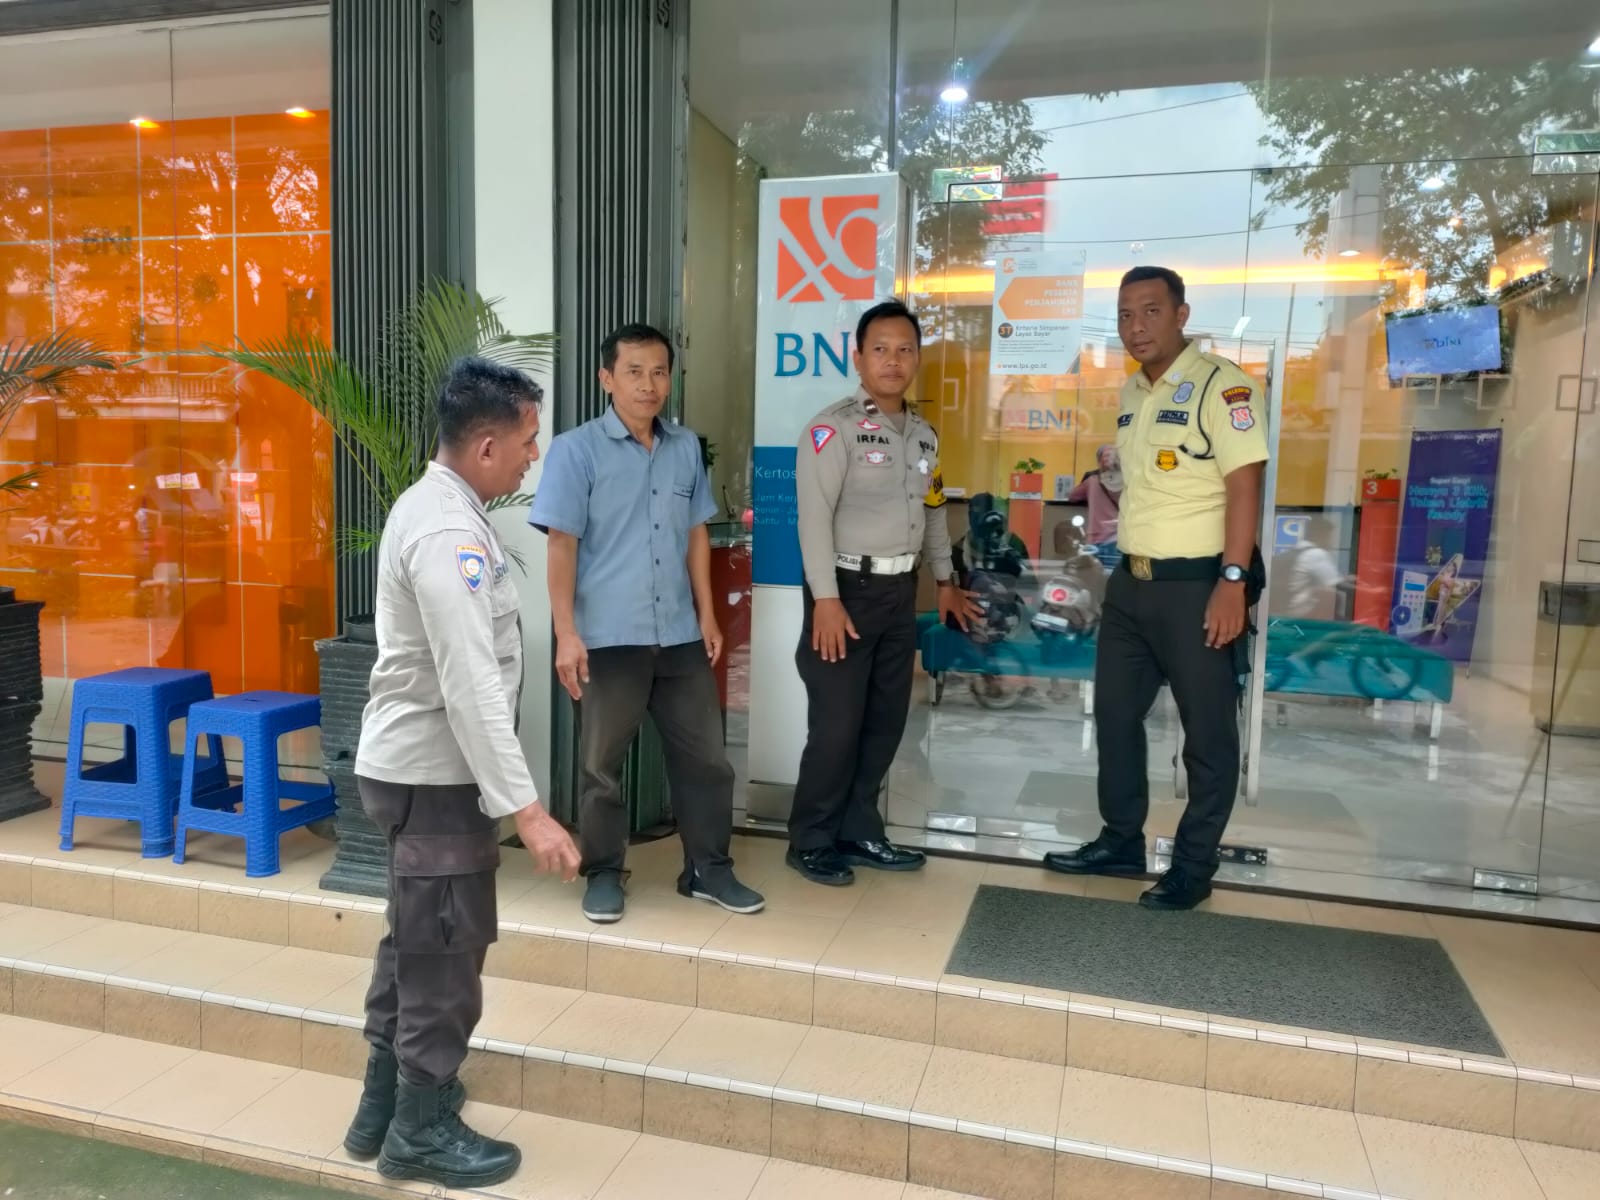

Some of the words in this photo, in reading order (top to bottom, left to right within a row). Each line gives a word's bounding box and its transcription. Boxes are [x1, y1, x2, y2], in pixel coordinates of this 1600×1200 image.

[774, 331, 851, 378] BN
[1028, 409, 1072, 430] BNI
[1013, 475, 1022, 488] 1
[1366, 481, 1378, 495] 3
